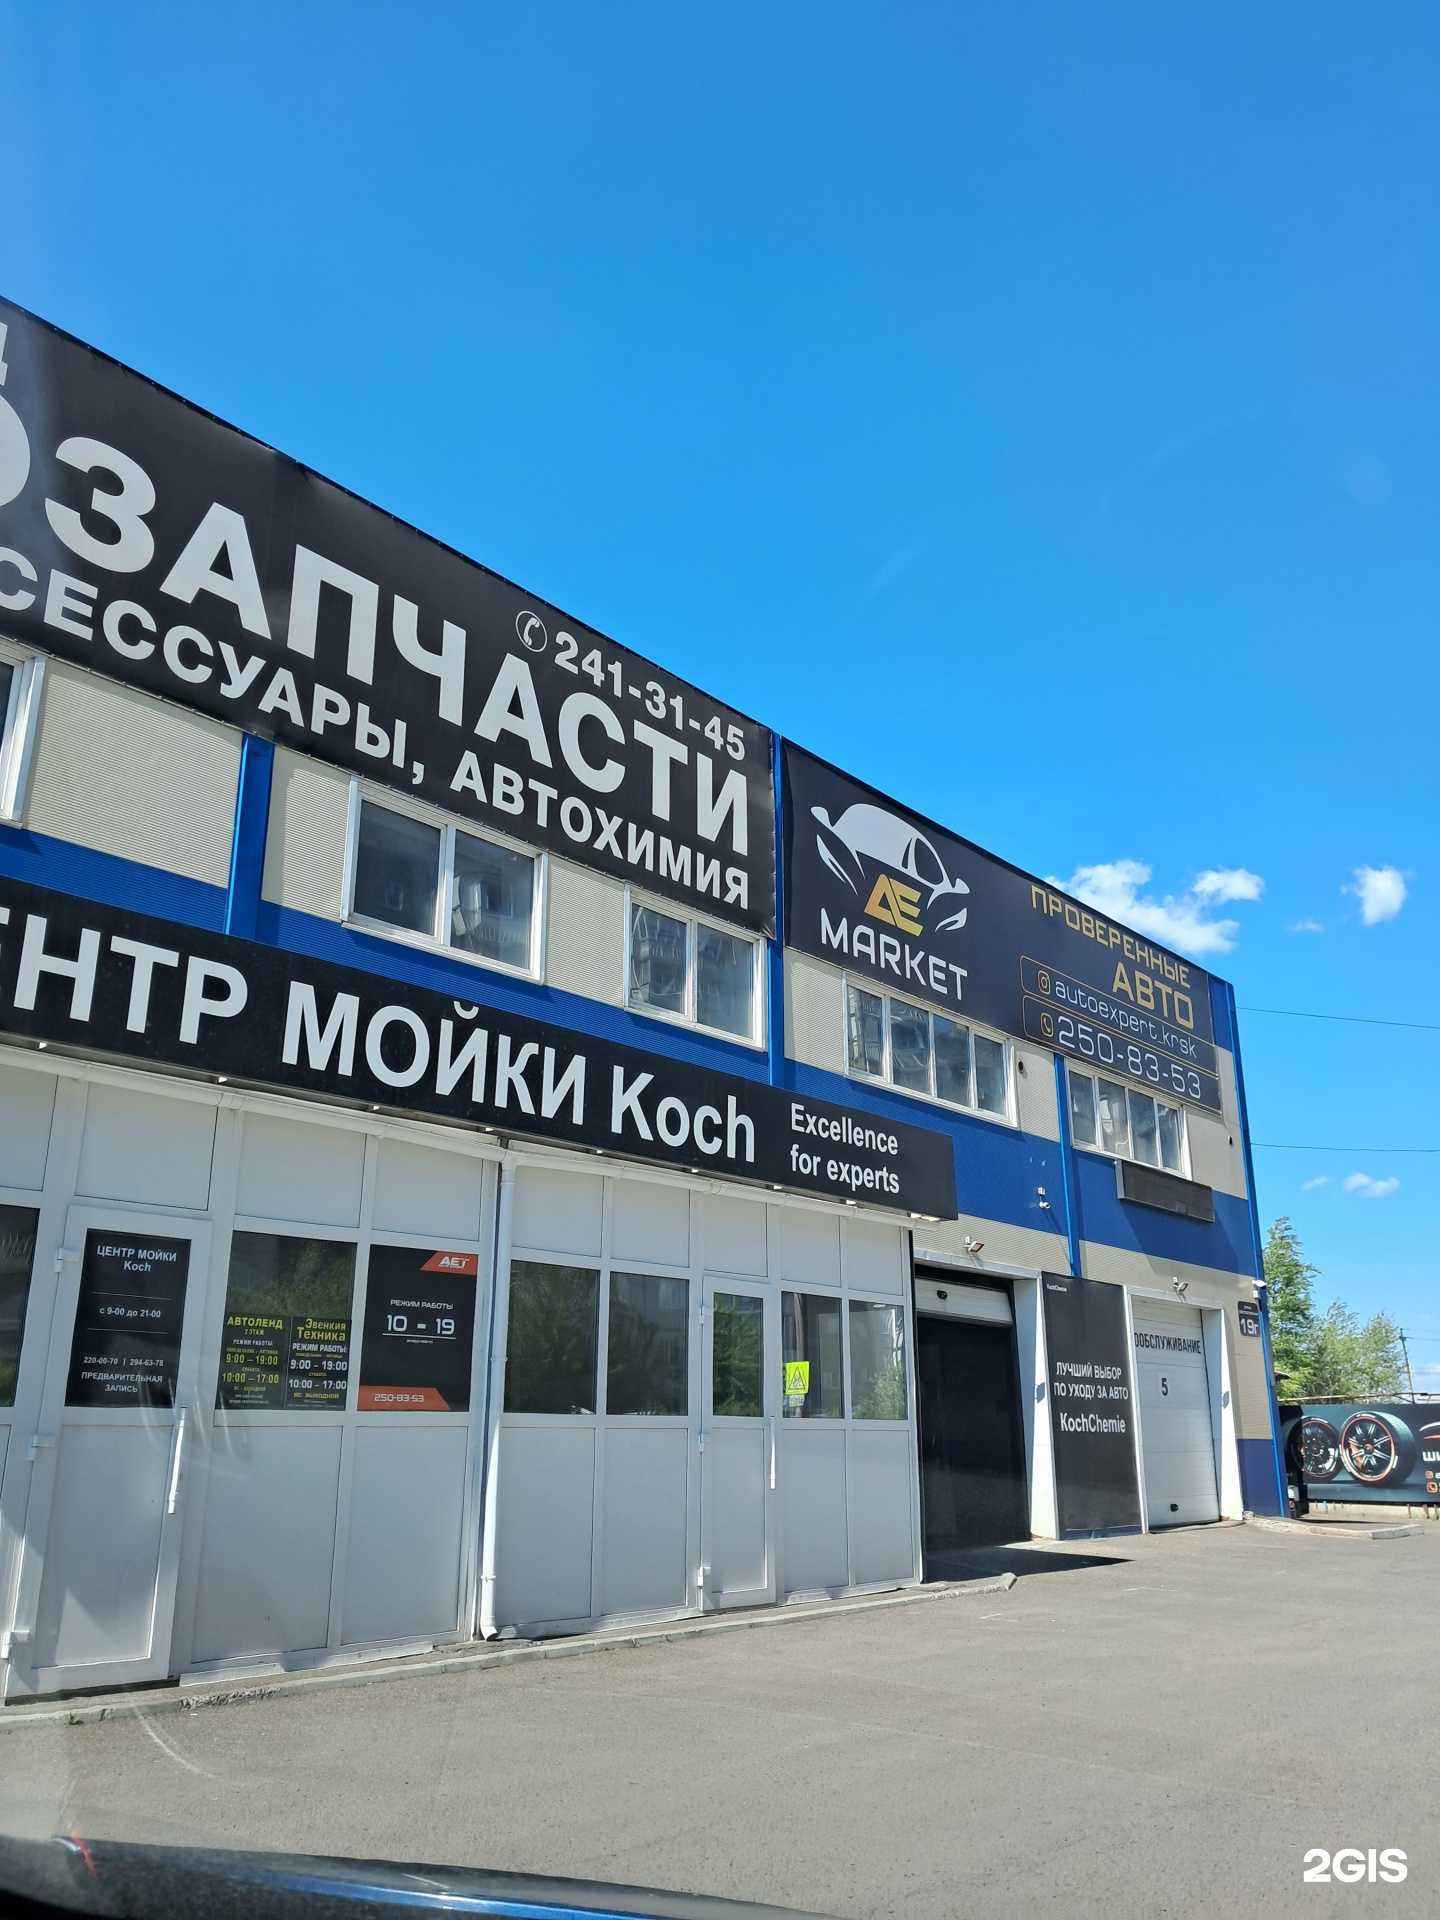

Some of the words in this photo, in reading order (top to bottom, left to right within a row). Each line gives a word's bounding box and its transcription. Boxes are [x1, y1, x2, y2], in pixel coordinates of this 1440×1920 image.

[554, 631, 746, 760] 241-31-45
[450, 750, 748, 909] АВТОХИМИЯ
[1031, 885, 1191, 989] ПРОВЕРЕННЫЕ
[821, 907, 968, 1000] MARKET
[1112, 962, 1194, 1029] АВТО
[0, 907, 249, 1045] НТР
[281, 981, 586, 1125] МОЙКИ
[611, 1065, 755, 1162] Koch
[1057, 1016, 1201, 1098] 250-83-53
[791, 1102, 899, 1155] Excellence
[790, 1144, 821, 1176] for
[827, 1160, 900, 1194] experts
[96, 1244, 135, 1258] ЦЕНТР
[137, 1248, 177, 1262] МОЙКИ
[123, 1260, 151, 1272] Koch
[106, 1306, 125, 1316] 9-00
[126, 1310, 138, 1318] до
[140, 1309, 161, 1318] 21-00
[390, 1299, 420, 1307] РЕЖИМ
[421, 1301, 454, 1310] РАБОТЫ
[227, 1316, 283, 1329] АВТОЛЕНД
[386, 1314, 408, 1332] 10
[435, 1318, 455, 1335] 19
[297, 1326, 346, 1341] Техника
[290, 1359, 311, 1370] 9:00
[321, 1360, 348, 1371] 19:00
[1056, 1361, 1093, 1378] ЛУЧШИЙ
[1093, 1364, 1122, 1380] ВЫБОР
[81, 1371, 163, 1383] ПРЕДВАРИТЕЛЬНАЯ
[289, 1379, 313, 1389] 10:00
[322, 1380, 347, 1390] 17:00
[1161, 1377, 1169, 1396] 5
[104, 1384, 138, 1393] ЗАПИСЬ
[1053, 1382, 1067, 1397] ПО
[1067, 1383, 1095, 1400] УХОДУ
[1096, 1385, 1108, 1399] ЗА
[1109, 1386, 1129, 1400] АВТО
[1060, 1412, 1126, 1433] KochChemie
